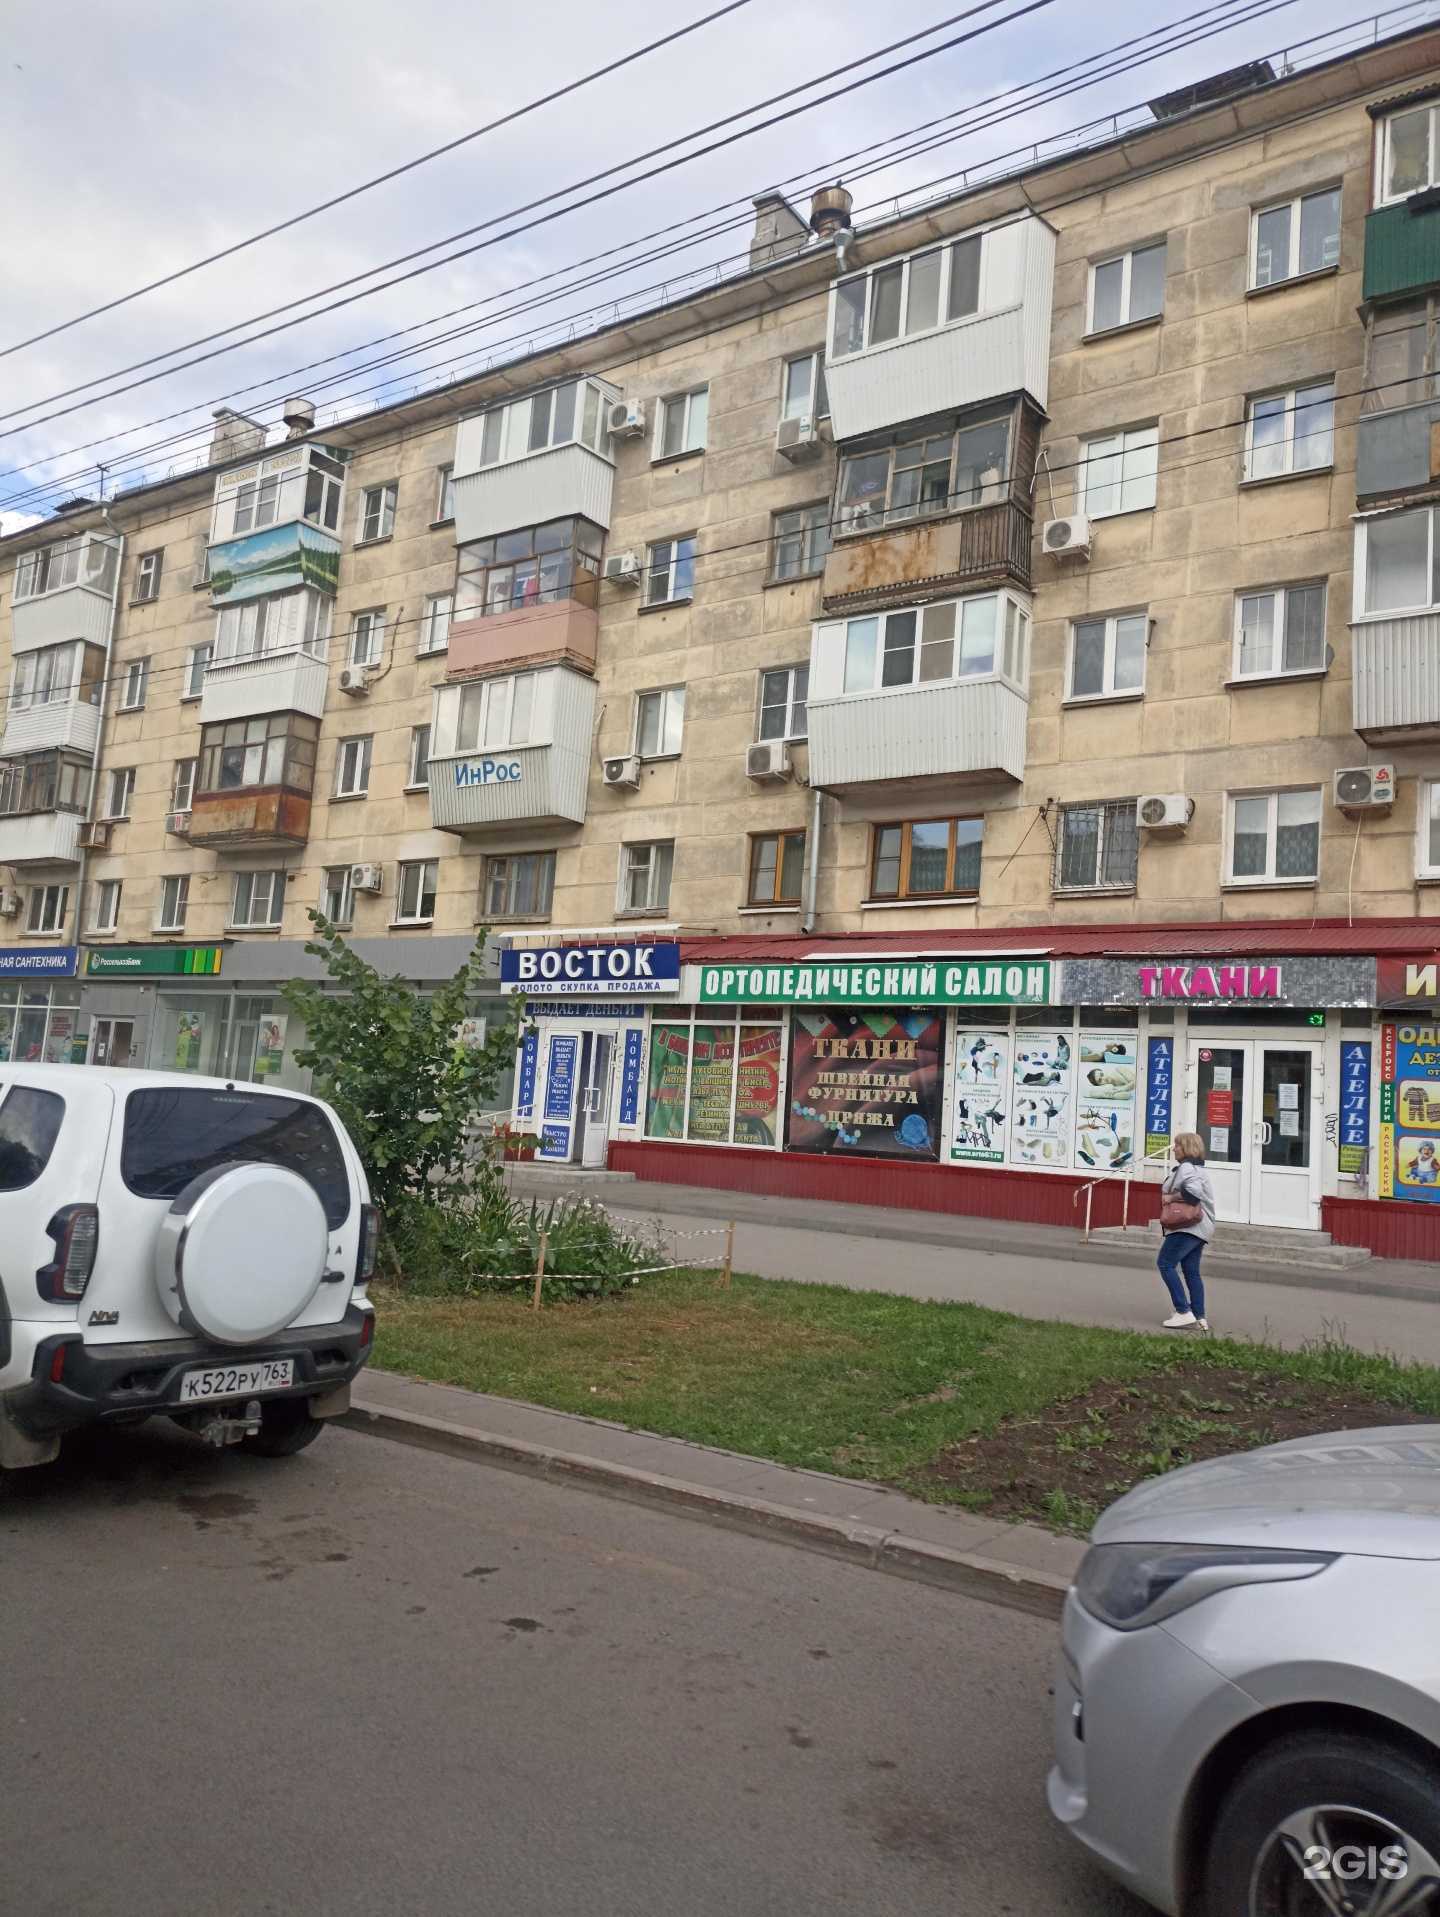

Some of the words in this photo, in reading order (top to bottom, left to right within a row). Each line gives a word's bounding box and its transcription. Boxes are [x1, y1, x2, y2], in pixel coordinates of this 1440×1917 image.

[15, 956, 67, 968] САНТЕХНИКА
[518, 947, 655, 980] ВОСТОК
[560, 982, 599, 992] СКУПКА
[607, 981, 661, 991] ПРОДАЖА
[704, 962, 938, 999] ОРТОПЕДИЧЕСКИЙ
[944, 965, 1045, 997] САЛОН
[1138, 965, 1282, 998] ТКАНИ
[812, 1038, 918, 1060] ТКАНИ
[624, 1033, 637, 1121] ЛОМБАРД
[816, 1070, 911, 1087] ШВЕЙНАЯ
[1150, 1042, 1171, 1132] АТЕЛЬЕ
[807, 1086, 919, 1105] ФУРНИТУРА
[1343, 1046, 1367, 1143] АТЕЛЬЕ
[826, 1110, 895, 1127] ПРЯЖА
[264, 1362, 288, 1381] 763
